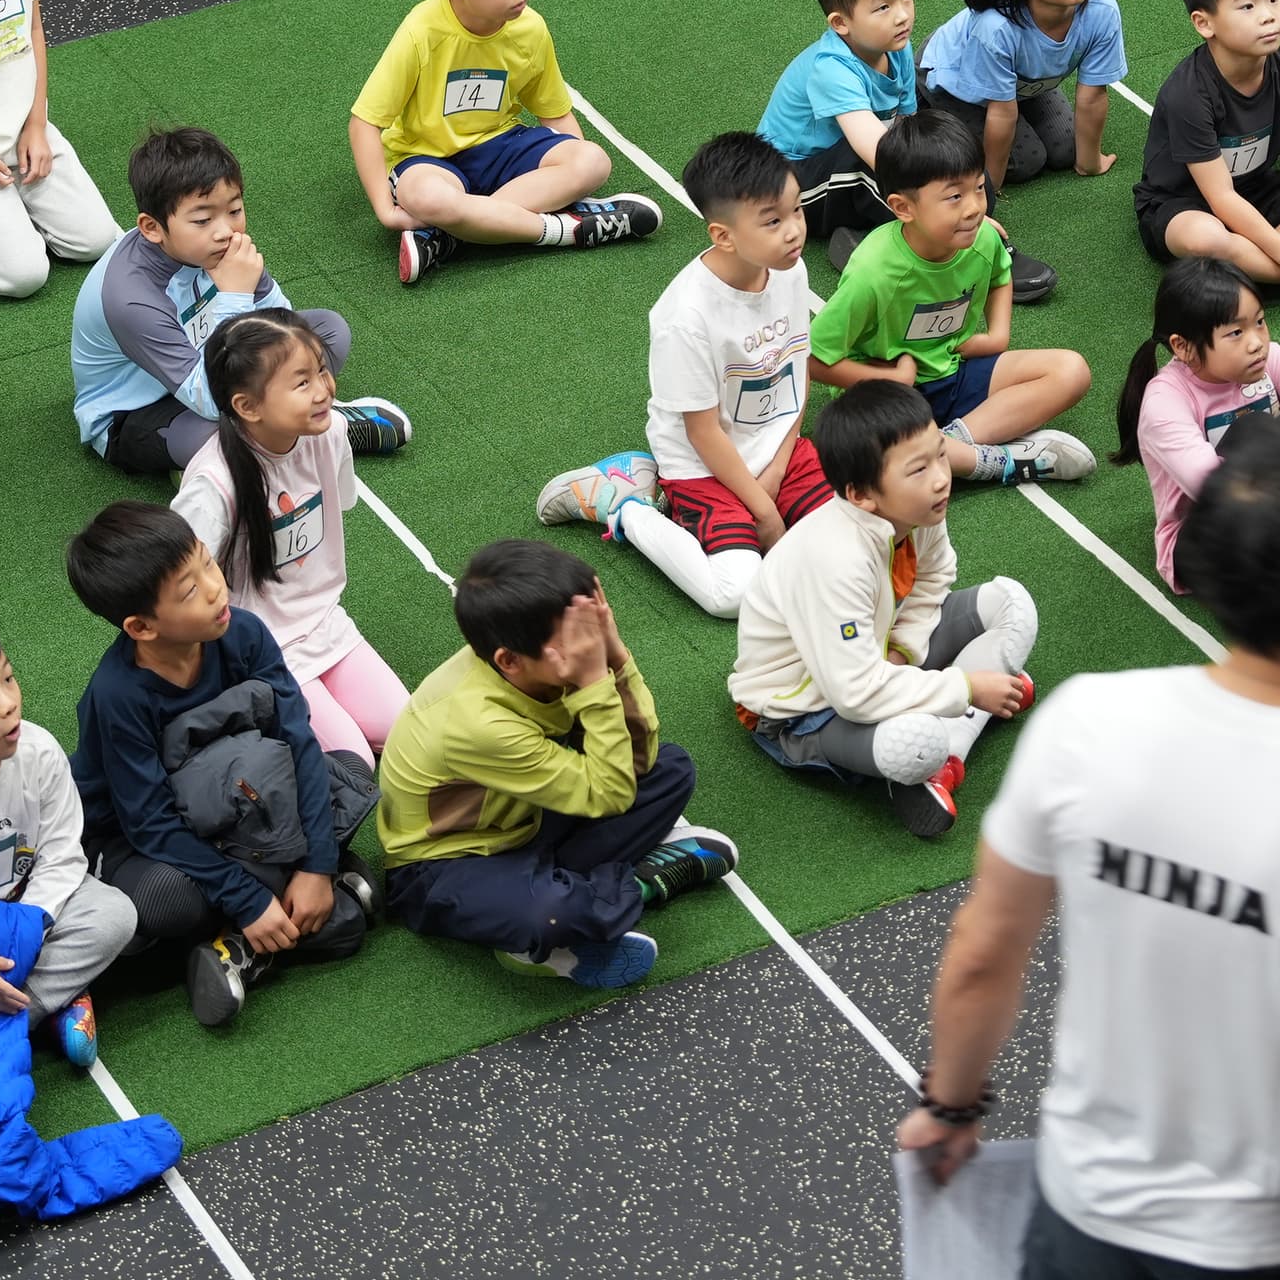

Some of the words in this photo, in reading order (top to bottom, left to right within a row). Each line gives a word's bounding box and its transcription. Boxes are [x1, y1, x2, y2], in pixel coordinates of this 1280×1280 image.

[456, 83, 485, 108] 14
[1229, 146, 1257, 173] 17
[192, 313, 209, 347] 15
[926, 315, 954, 333] 10
[757, 388, 778, 417] 21
[285, 521, 308, 558] 16
[1091, 837, 1272, 936] NINJA
